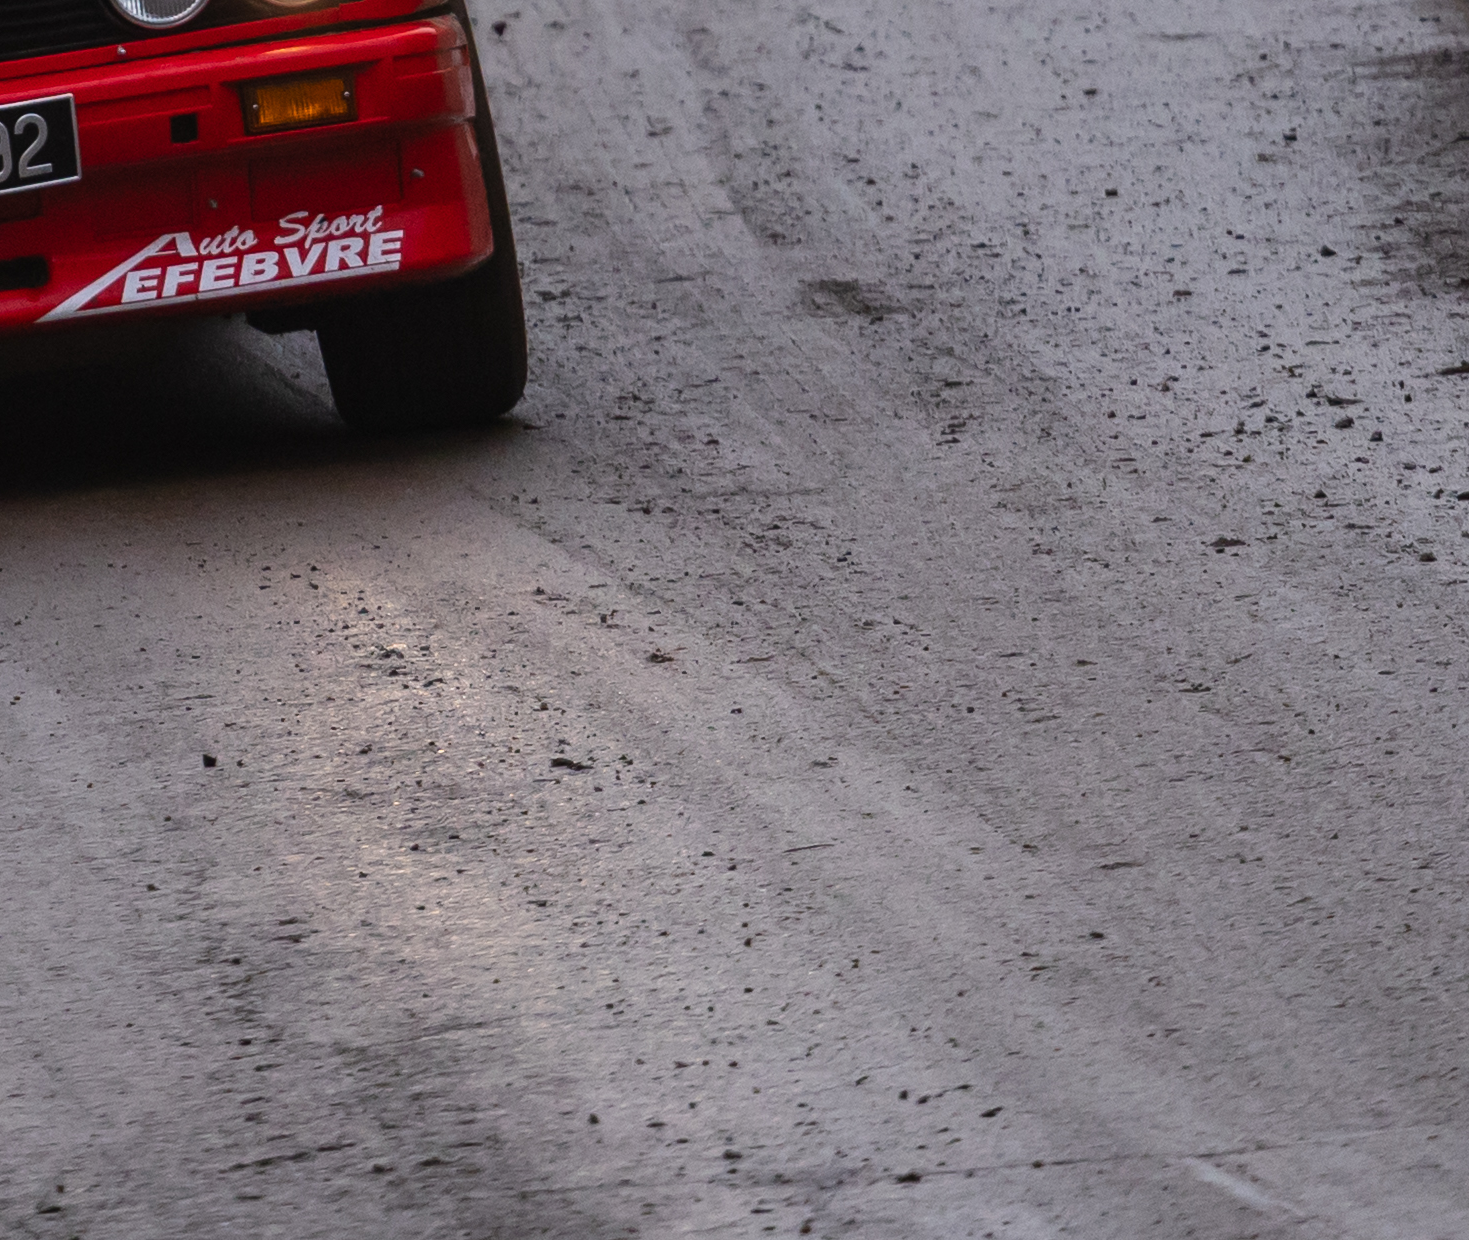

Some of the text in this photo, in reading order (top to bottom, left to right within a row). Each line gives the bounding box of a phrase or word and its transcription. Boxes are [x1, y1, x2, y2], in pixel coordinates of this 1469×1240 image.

[145, 204, 383, 258] Auto Sport
[34, 229, 404, 324] LEFEBVRE
